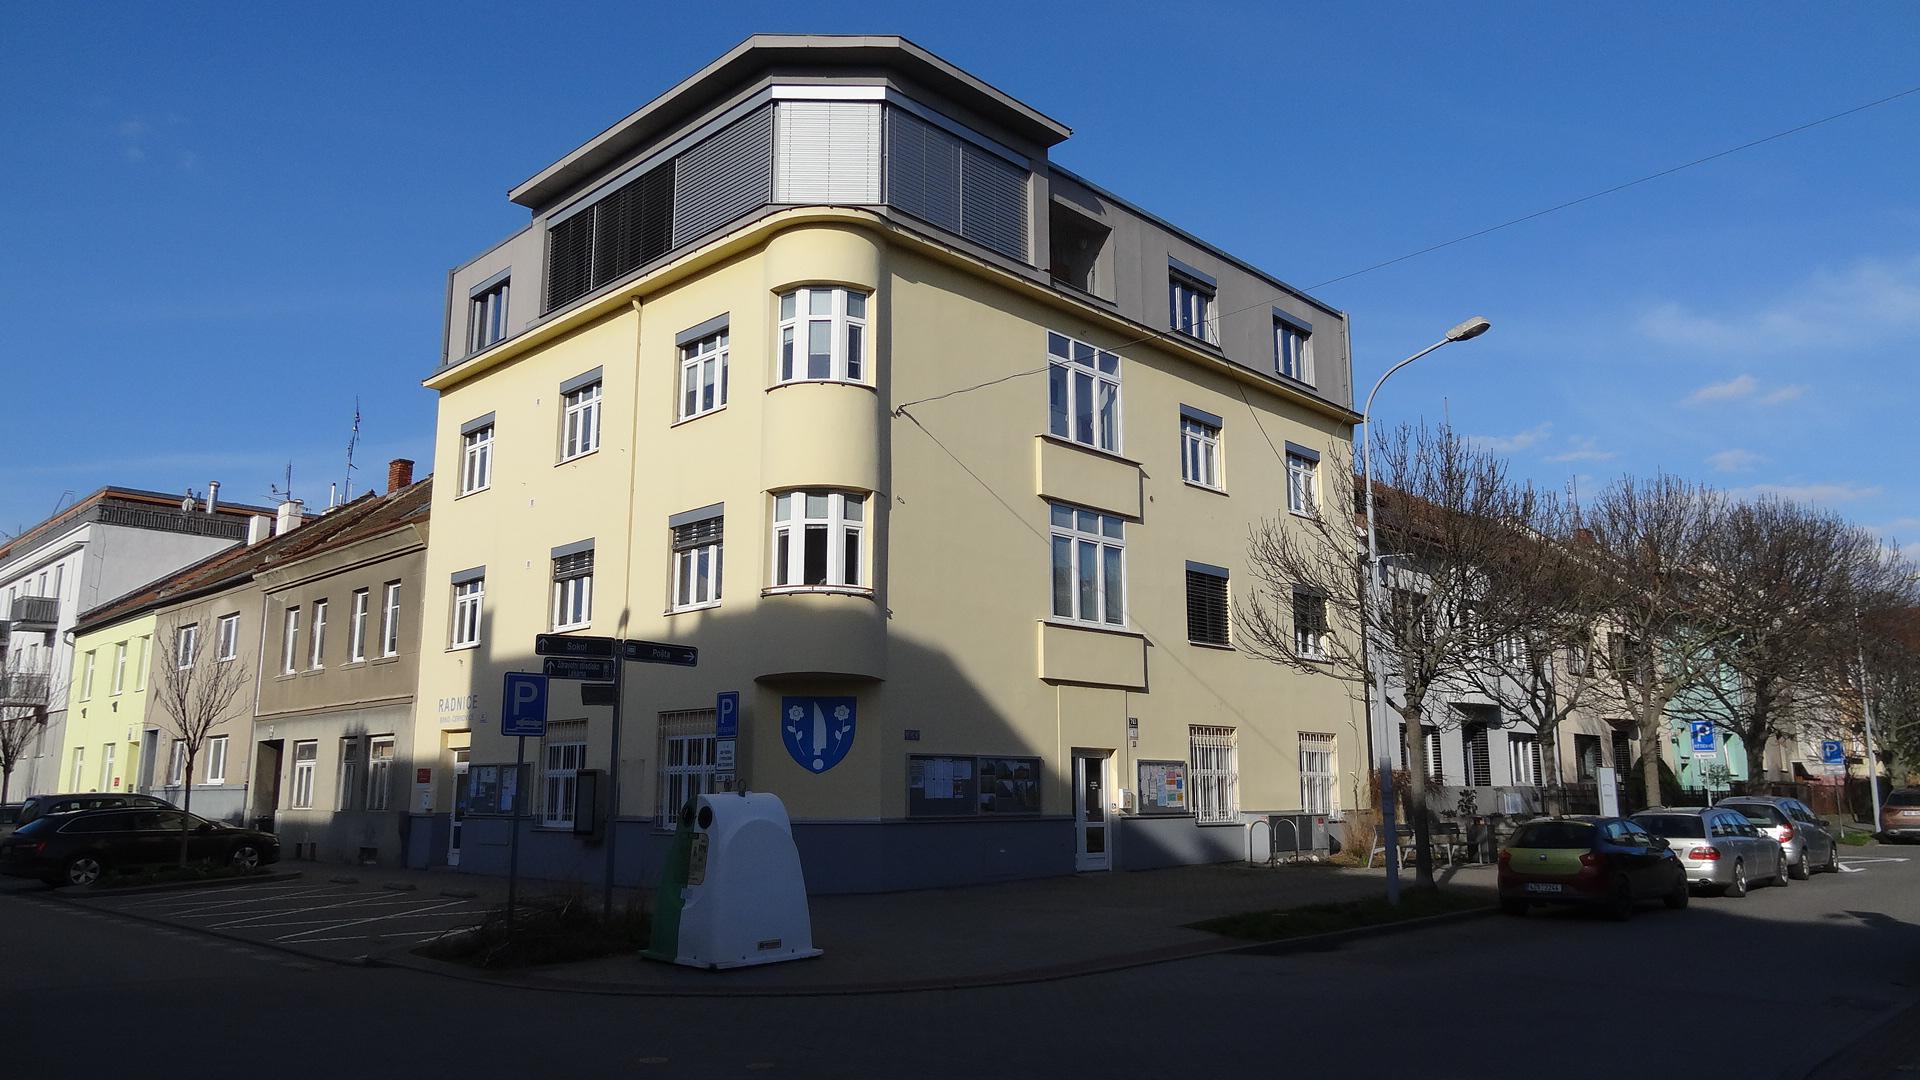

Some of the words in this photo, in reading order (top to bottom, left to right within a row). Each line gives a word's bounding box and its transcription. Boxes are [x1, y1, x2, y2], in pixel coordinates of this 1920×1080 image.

[567, 642, 587, 651] Sokol
[652, 648, 671, 659] Pošta
[439, 695, 478, 712] RADNICE
[513, 681, 538, 715] P
[721, 698, 733, 724] P
[1696, 724, 1711, 742] P
[1826, 743, 1838, 757] P
